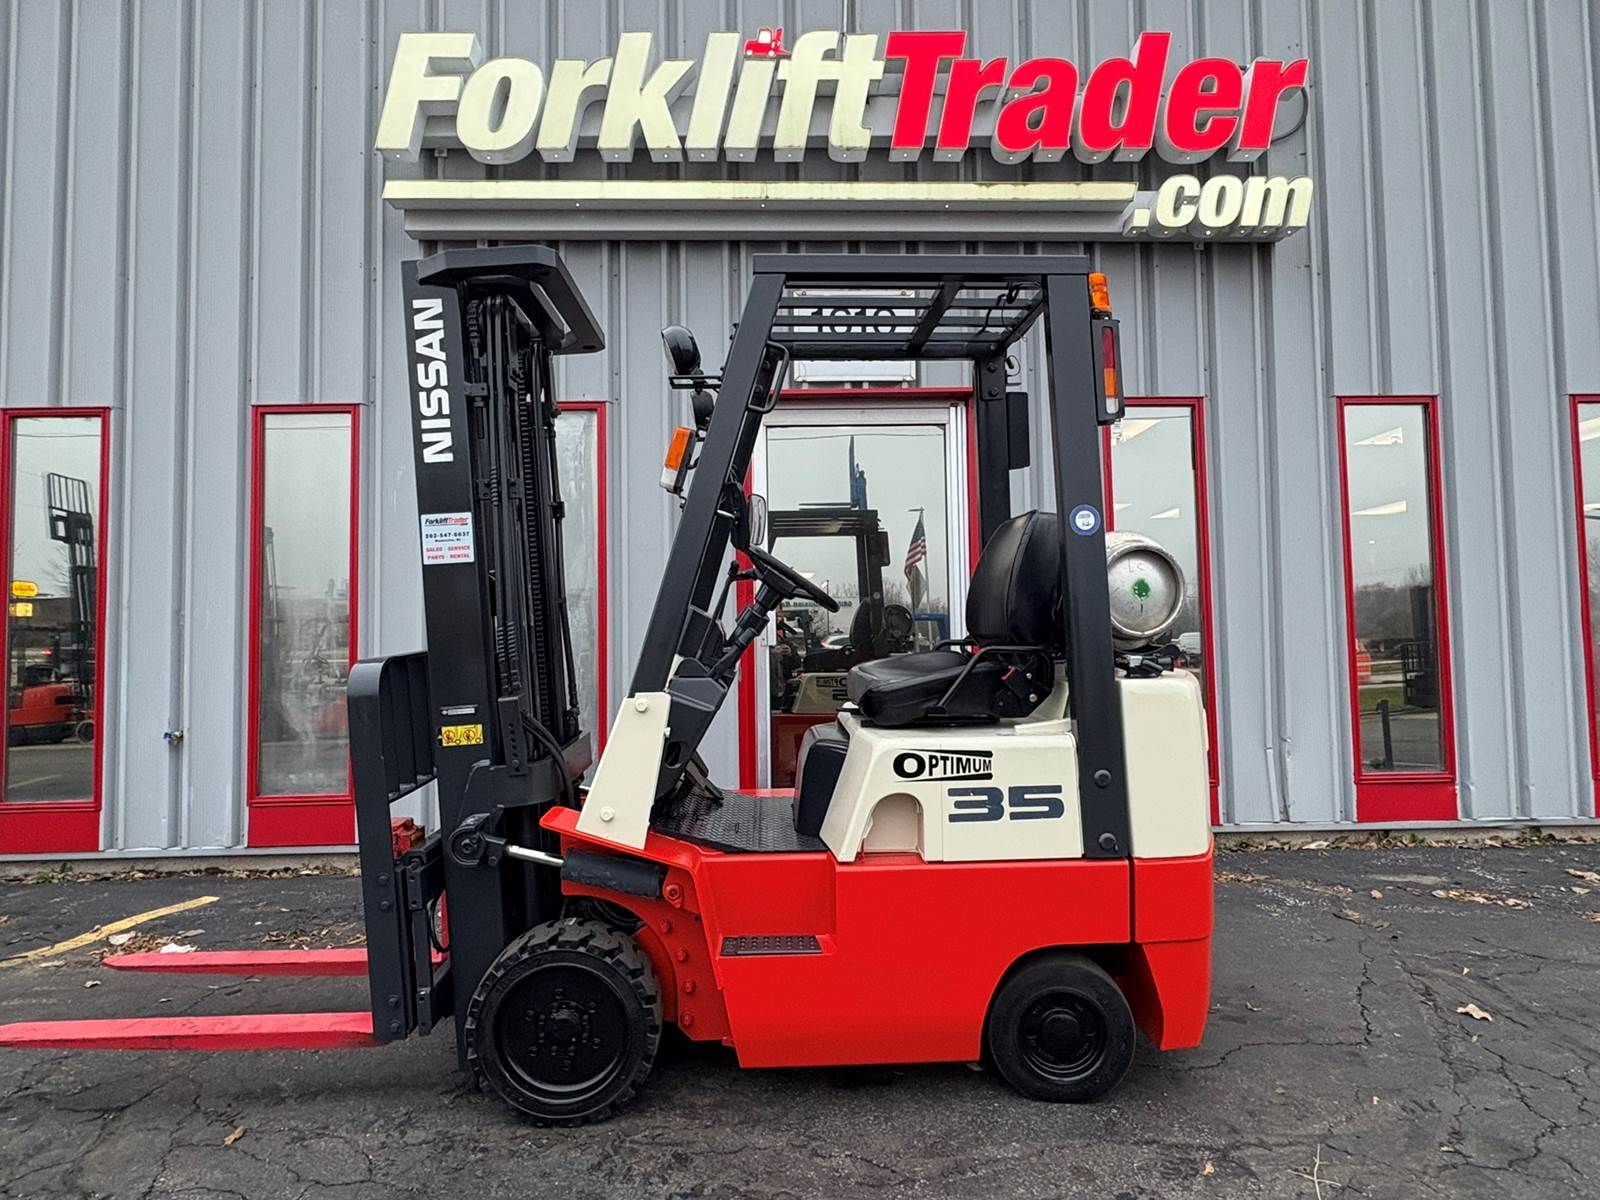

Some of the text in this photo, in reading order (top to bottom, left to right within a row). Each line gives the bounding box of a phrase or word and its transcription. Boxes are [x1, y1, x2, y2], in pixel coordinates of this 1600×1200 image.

[375, 29, 1309, 157] ForkliftTrader
[1134, 173, 1313, 231] .com
[412, 298, 454, 463] NISSAN
[893, 752, 992, 779] OPTIMUM
[948, 784, 1065, 823] 35
